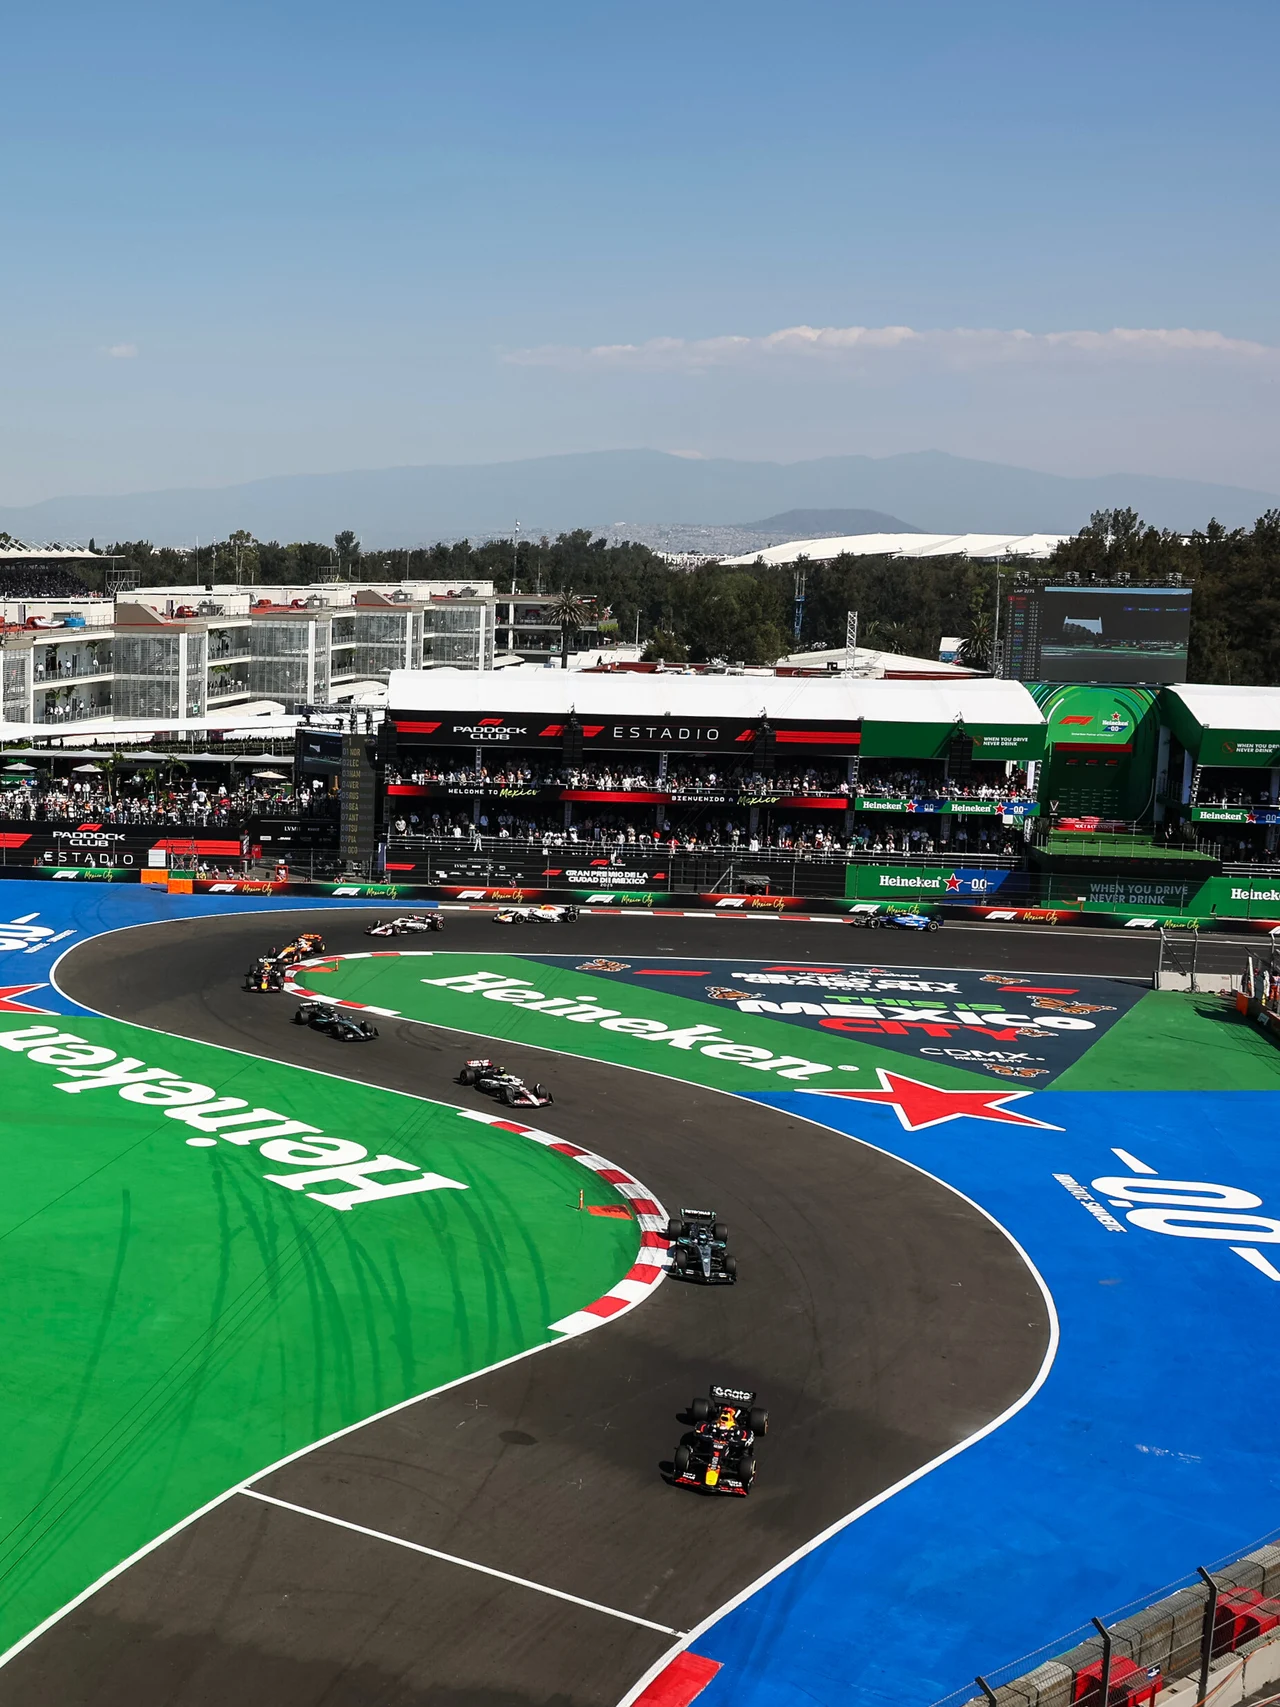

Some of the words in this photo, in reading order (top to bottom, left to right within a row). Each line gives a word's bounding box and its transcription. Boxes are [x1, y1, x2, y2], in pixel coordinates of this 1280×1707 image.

[453, 726, 528, 735] PADDOCK
[470, 733, 510, 741] CLUB
[613, 727, 719, 741] ESTADIO
[349, 759, 359, 767] LEC
[52, 831, 125, 841] PADDOCK
[43, 851, 134, 865] ESTADIO
[879, 875, 940, 888] Heineken
[1090, 884, 1124, 893] WHEN
[1128, 885, 1152, 894] YOU
[1155, 886, 1189, 895] DRIVE
[1231, 888, 1280, 901] Heinek
[1089, 894, 1125, 903] NEVER
[1129, 895, 1165, 904] DRINK
[731, 973, 872, 984] MEXICO
[877, 979, 958, 990] CITY
[824, 995, 947, 1009] THIS
[955, 1003, 1006, 1012] IS
[736, 1000, 1096, 1030] MEXICO
[421, 971, 833, 1081] Heineken
[819, 1018, 1019, 1041] CITY
